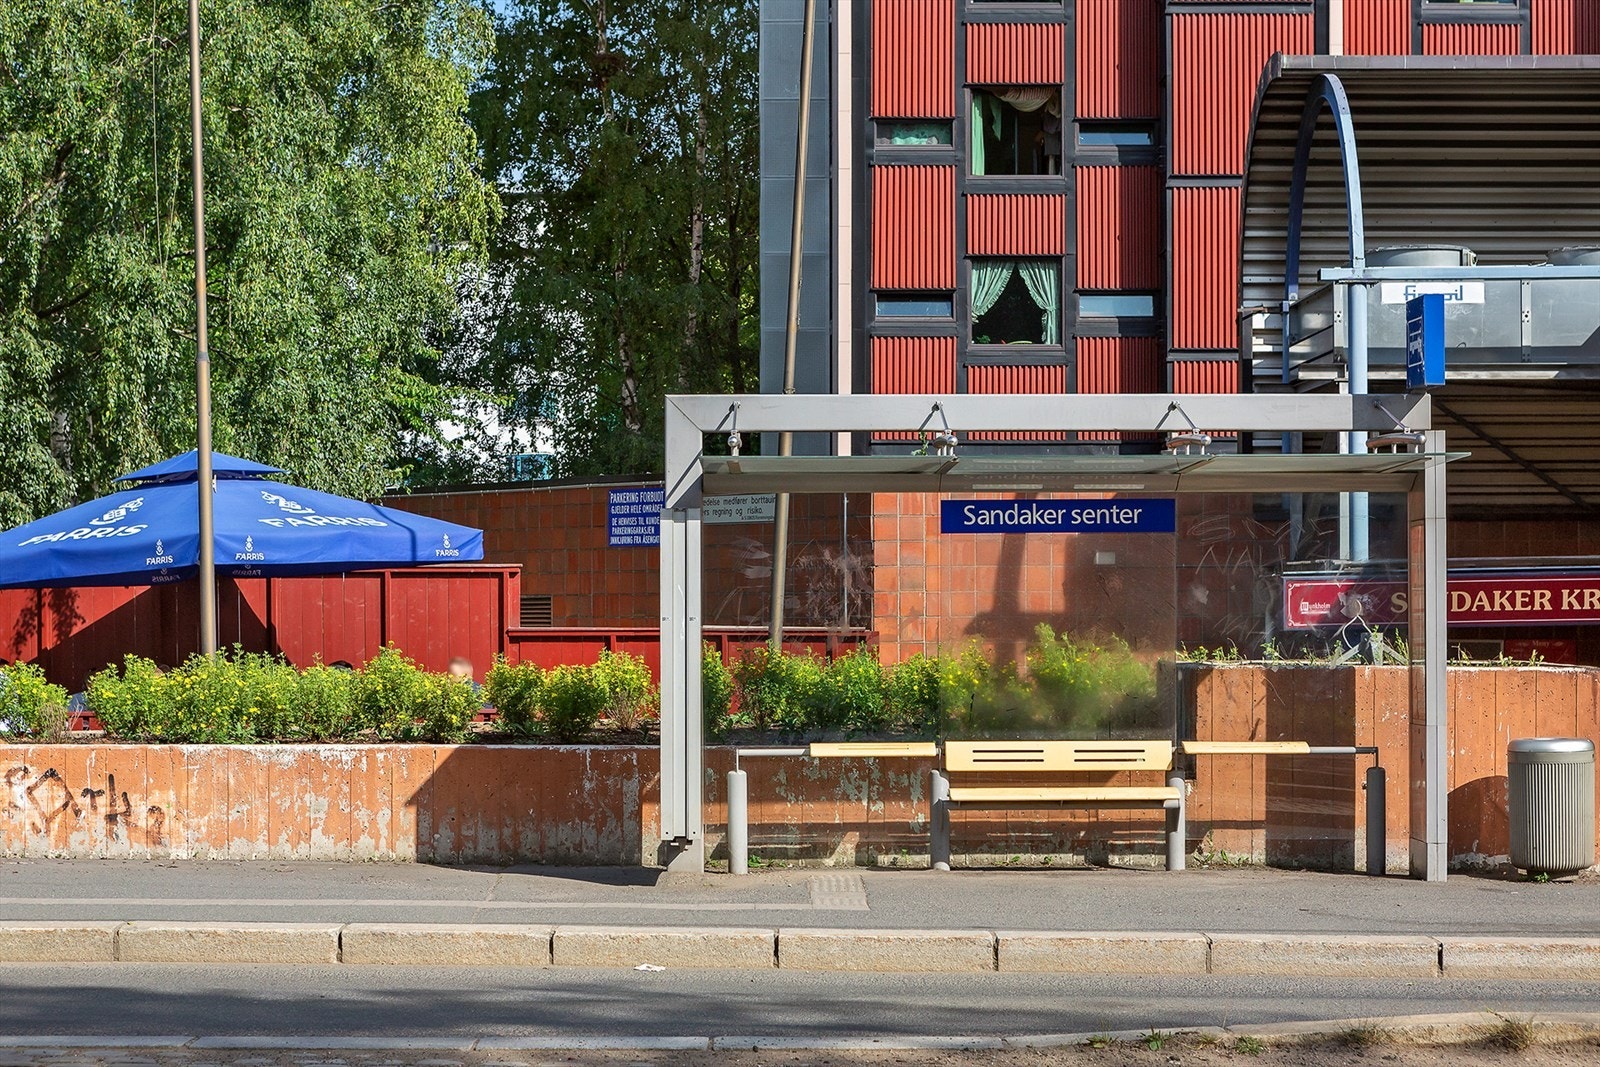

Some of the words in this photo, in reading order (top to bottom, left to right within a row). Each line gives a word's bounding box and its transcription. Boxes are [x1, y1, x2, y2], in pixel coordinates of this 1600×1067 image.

[610, 492, 639, 503] PARKERING
[640, 491, 664, 502] FORBUDT
[611, 505, 630, 514] GJELDER
[630, 505, 642, 514] HELE
[713, 508, 732, 517] regning
[736, 508, 743, 516] og
[963, 504, 1066, 525] Sandaker
[1071, 505, 1142, 524] senter
[257, 515, 388, 528] FARRIS
[612, 518, 618, 526] DE
[18, 524, 148, 547] FARRIS
[634, 536, 642, 544] FRA
[235, 553, 265, 561] FARRIS
[434, 549, 459, 557] FARRIS
[146, 555, 174, 565] FARRIS
[1391, 590, 1553, 612] SDAKER
